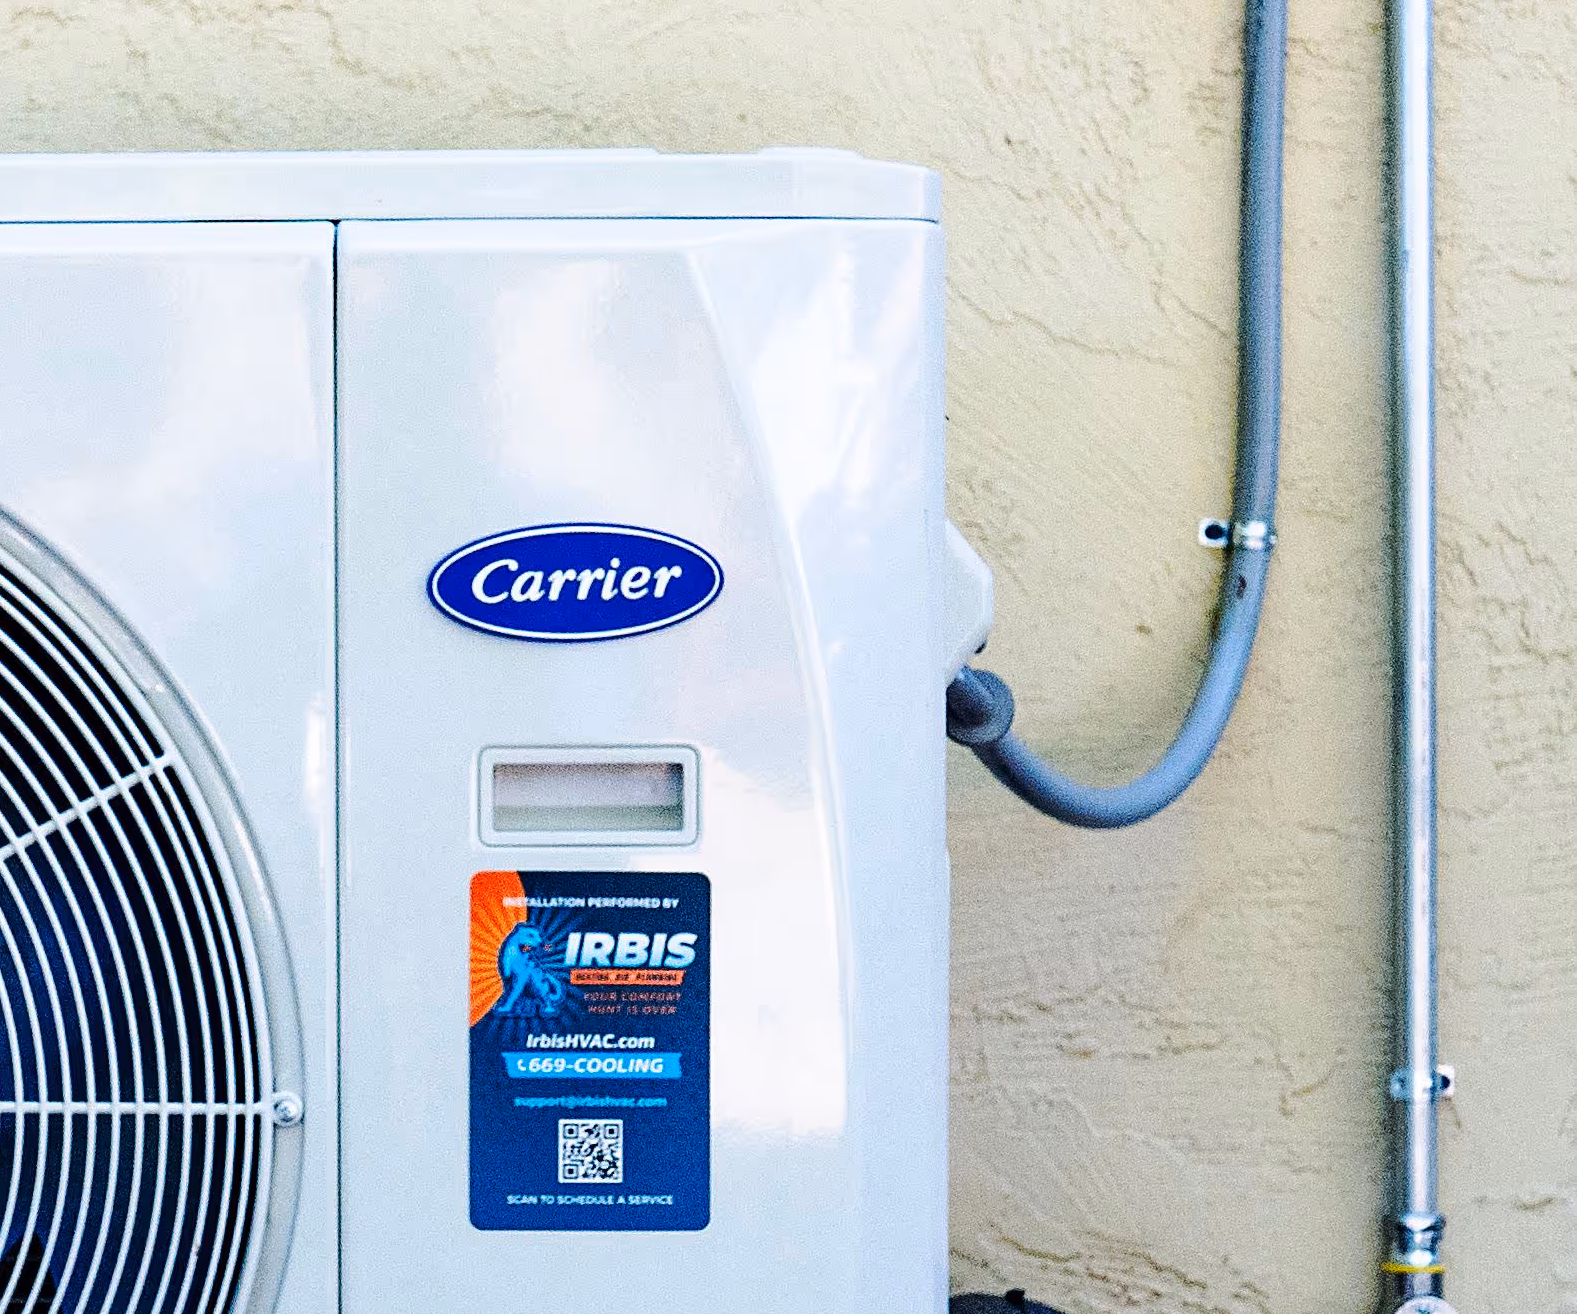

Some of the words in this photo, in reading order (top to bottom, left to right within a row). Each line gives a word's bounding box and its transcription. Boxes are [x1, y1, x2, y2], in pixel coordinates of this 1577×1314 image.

[471, 557, 683, 605] Carrier
[502, 896, 585, 908] INSTALLATION
[587, 896, 661, 909] PERFORMED
[662, 896, 680, 909] BY
[565, 931, 698, 969] IRBIS
[526, 1033, 656, 1049] IrbisHVAC.com
[529, 1057, 664, 1073] 669-COOLING
[514, 1095, 667, 1109] support@irbishvac.com
[506, 1194, 538, 1205] SCAN
[540, 1194, 555, 1205] TO
[556, 1194, 614, 1205] SCHEDULE
[616, 1194, 626, 1205] A
[627, 1194, 674, 1205] SERVICE
